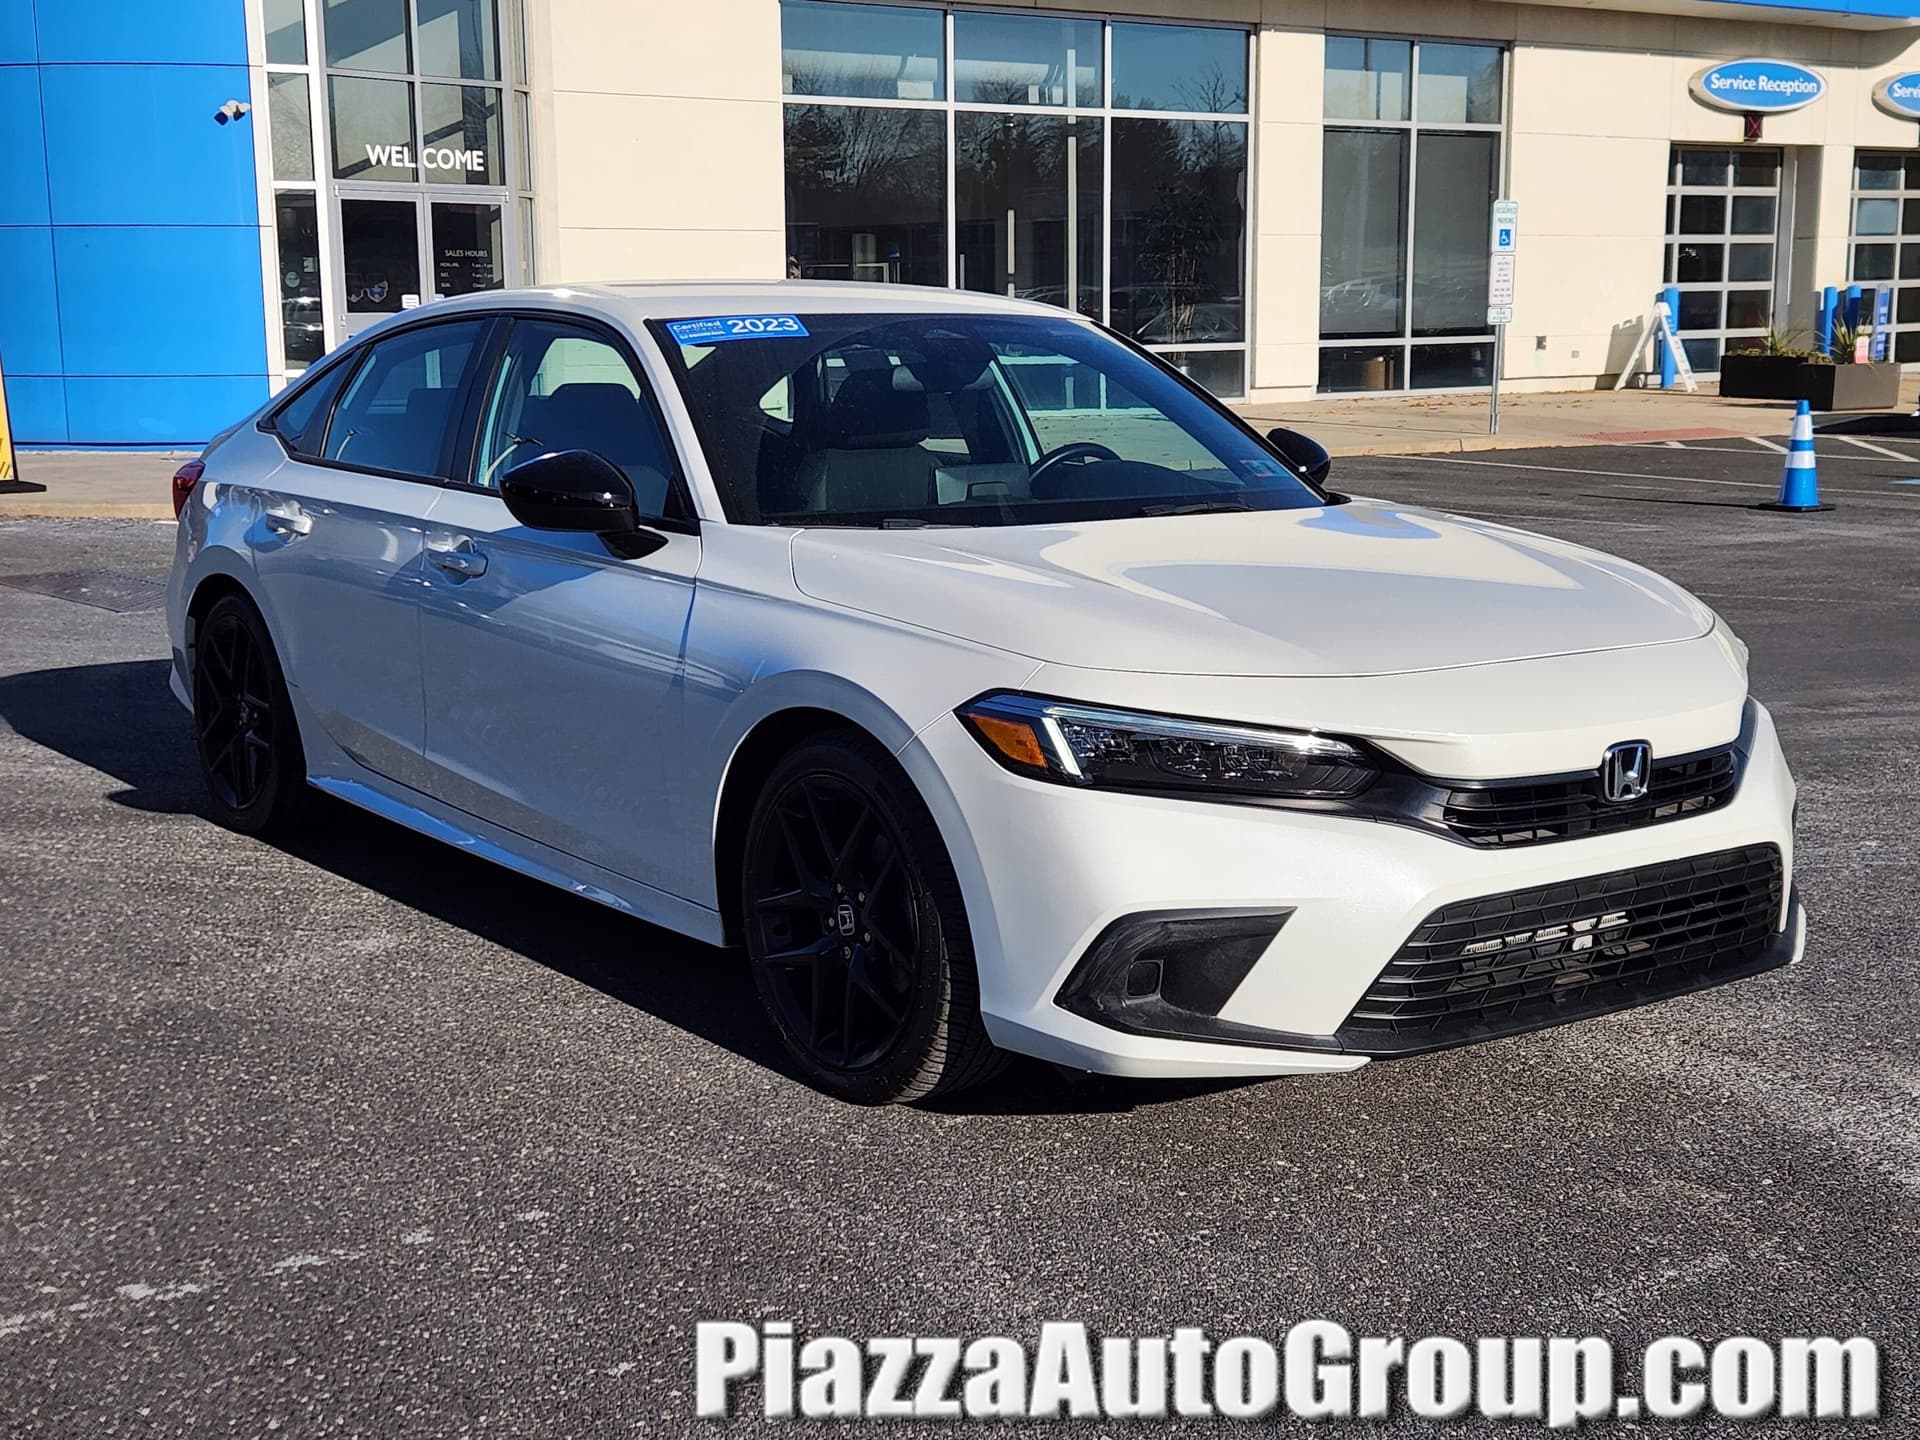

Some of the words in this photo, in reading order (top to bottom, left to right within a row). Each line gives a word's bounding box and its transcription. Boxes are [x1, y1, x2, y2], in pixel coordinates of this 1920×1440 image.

[1711, 73, 1756, 90] Service
[1758, 75, 1817, 96] Reception
[365, 144, 485, 171] WELCOME
[444, 249, 464, 257] SALES
[465, 249, 488, 257] HOURS
[673, 320, 721, 330] Certified
[727, 317, 799, 333] 2023
